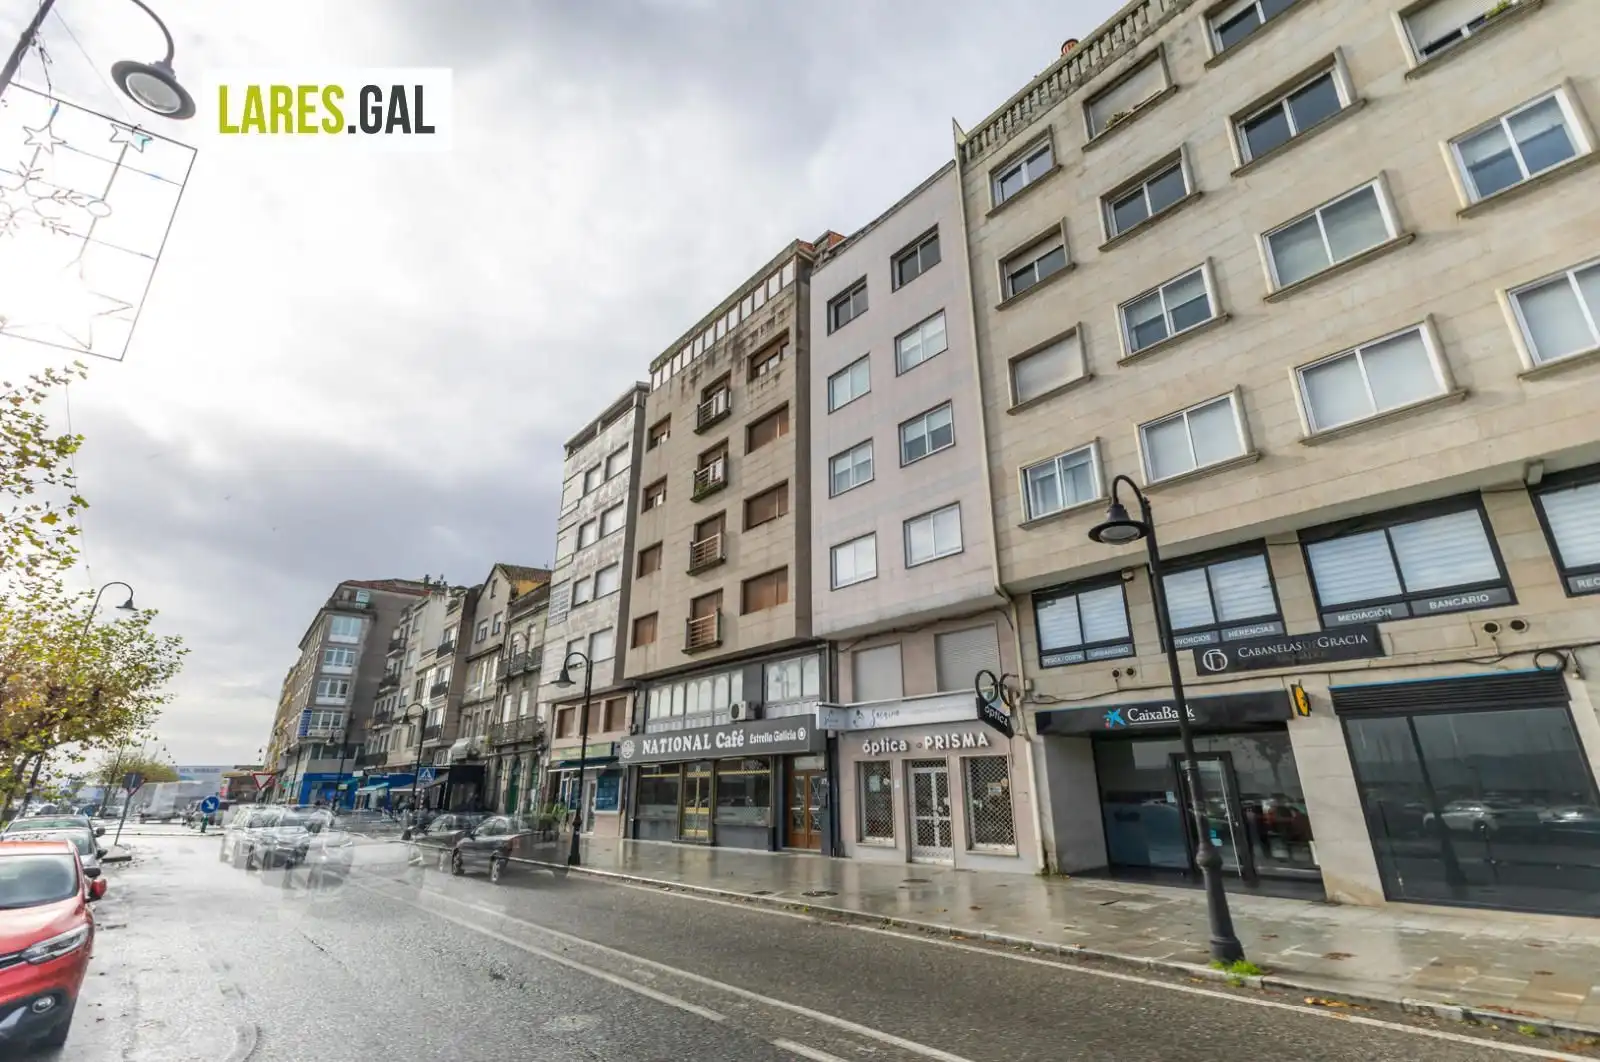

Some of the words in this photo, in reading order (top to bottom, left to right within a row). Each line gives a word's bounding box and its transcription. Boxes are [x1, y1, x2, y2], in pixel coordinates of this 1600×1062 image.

[1429, 593, 1490, 610] BANCARIO
[1337, 607, 1392, 623] MEDIACIÓN
[1228, 624, 1275, 638] HERENCIAS
[1238, 640, 1302, 658] CABANELAS
[1317, 633, 1369, 648] GRACIA
[1127, 704, 1195, 721] CaixaBak
[642, 733, 712, 755] NATIONAL
[716, 728, 744, 749] Café
[749, 731, 773, 744] Estrella
[862, 737, 908, 755] óptica
[924, 731, 989, 750] PRISMA
